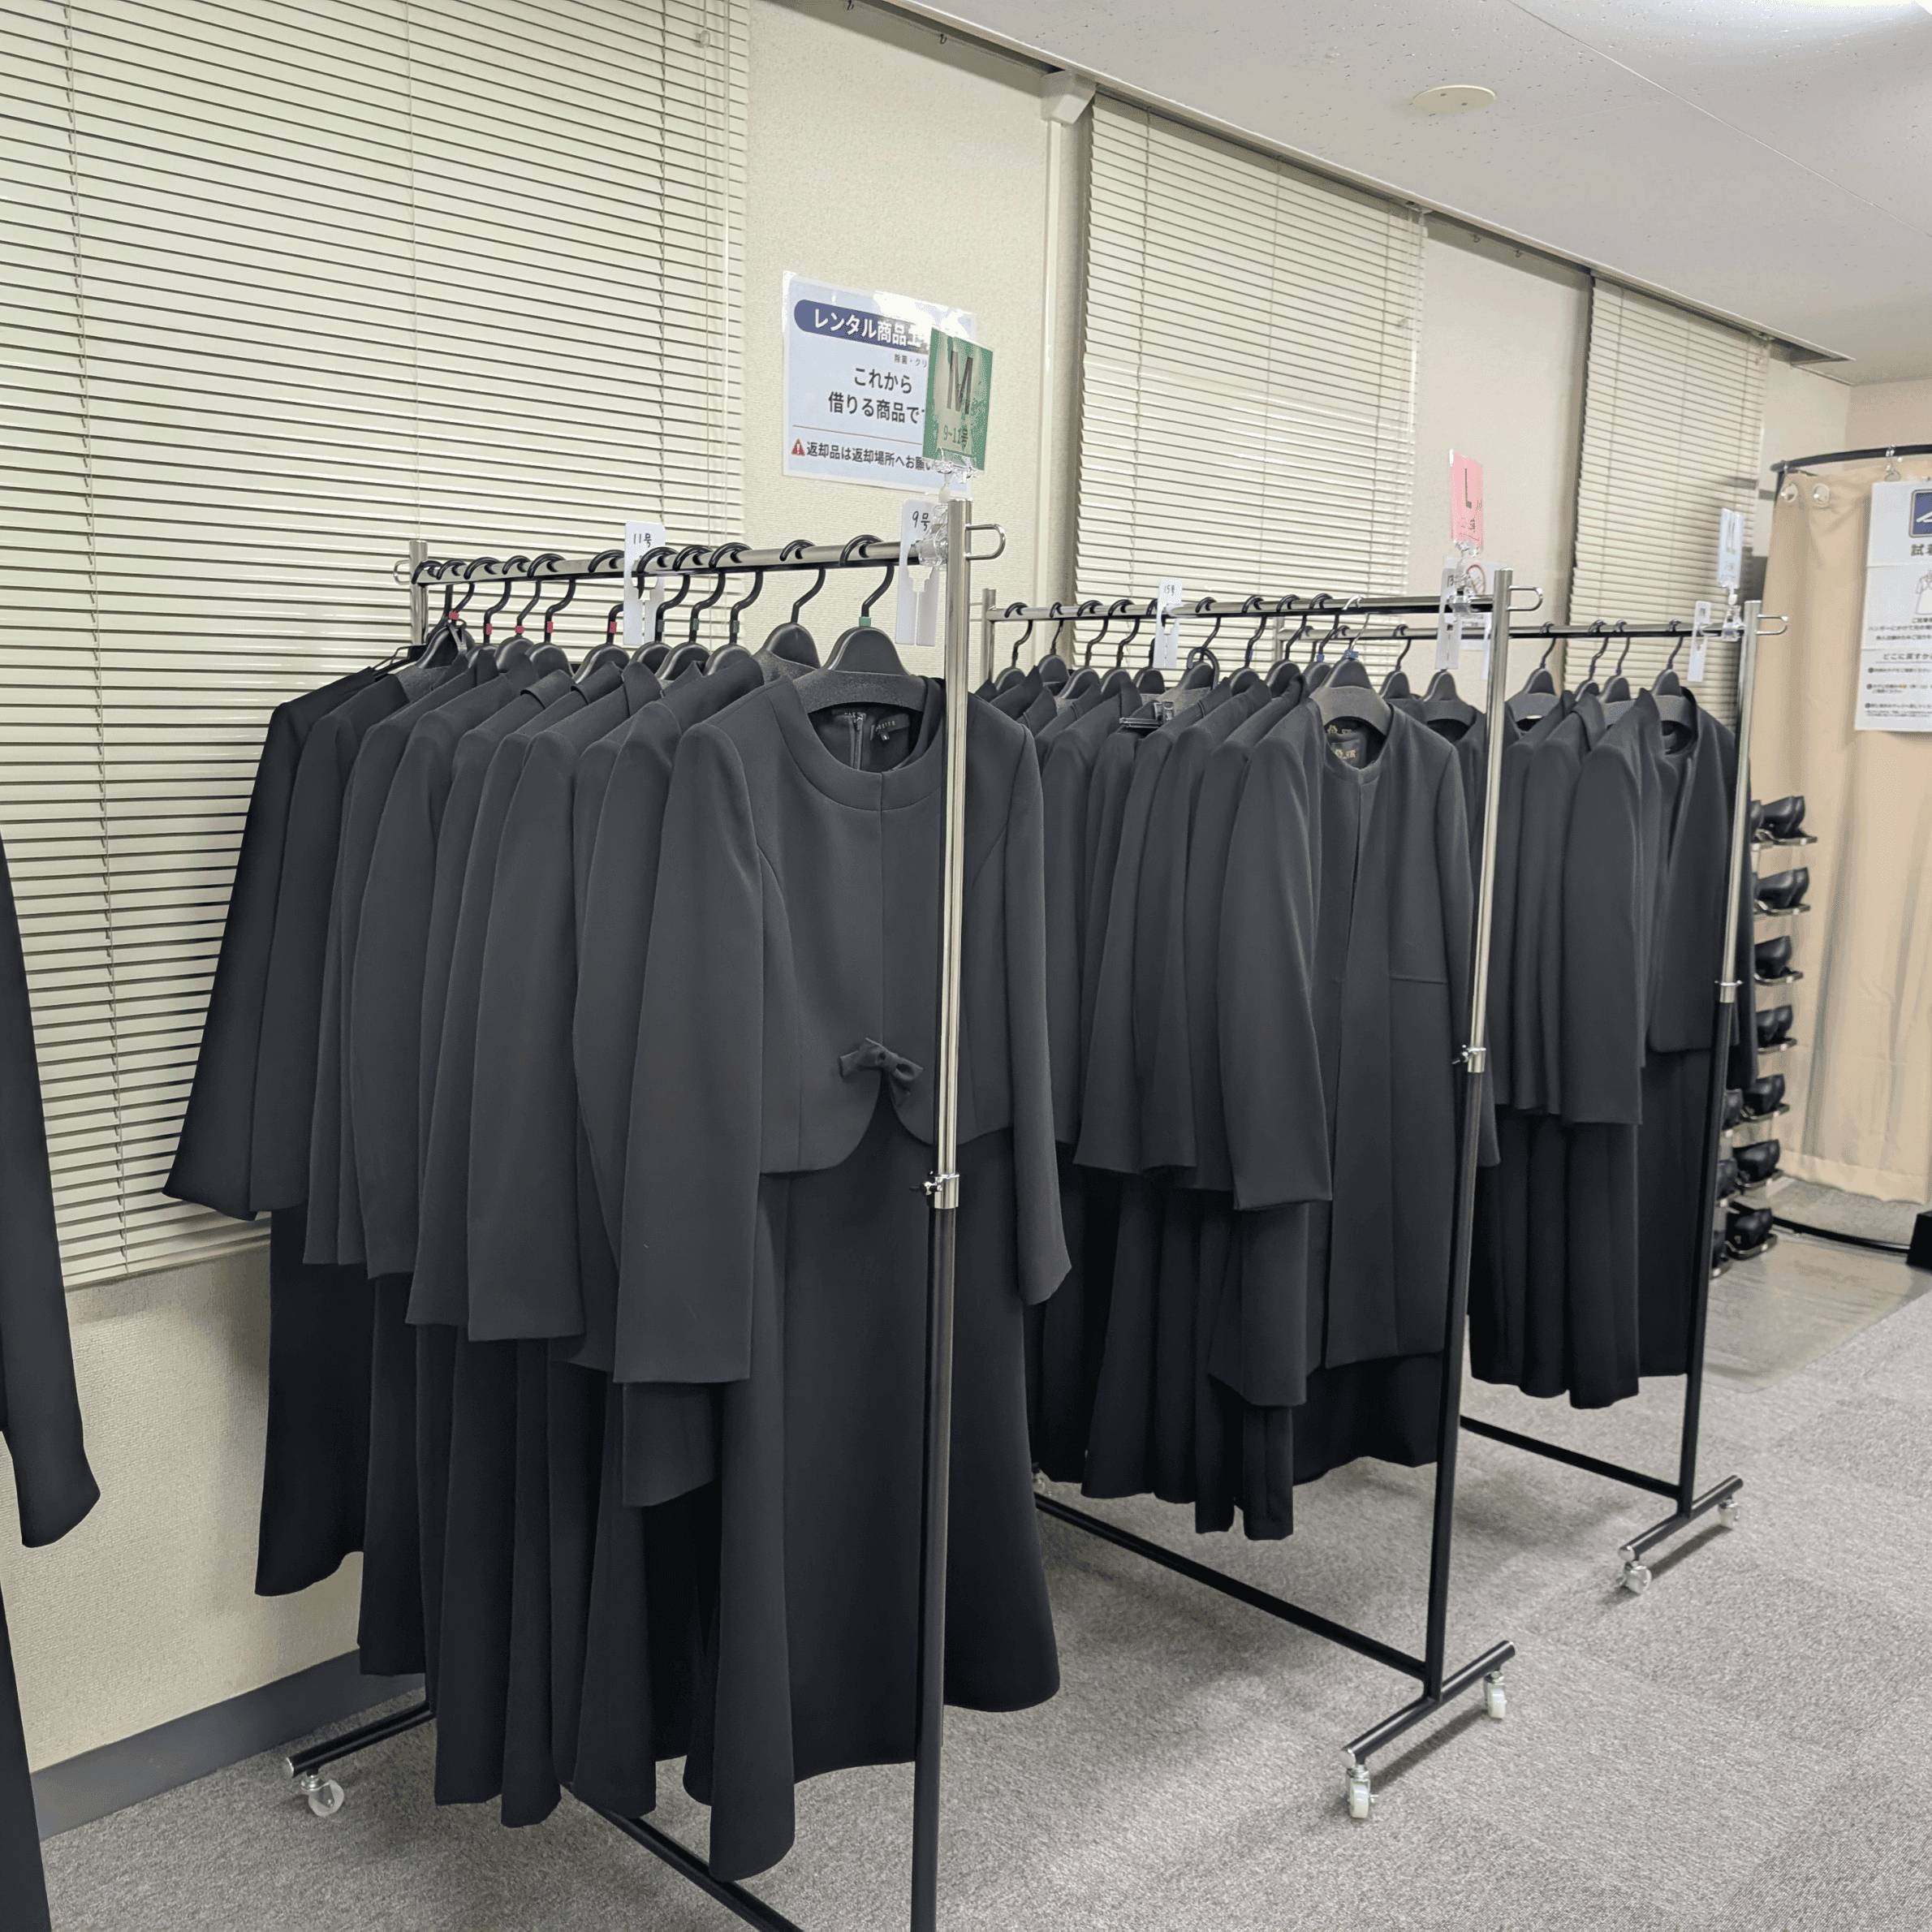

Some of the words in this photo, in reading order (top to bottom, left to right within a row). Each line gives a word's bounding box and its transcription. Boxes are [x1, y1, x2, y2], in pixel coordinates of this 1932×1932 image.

[854, 368, 912, 394] これから
[947, 350, 973, 415] M
[828, 390, 925, 425] 借りる商品で
[912, 511, 931, 532] 9号
[633, 533, 652, 549] 11号
